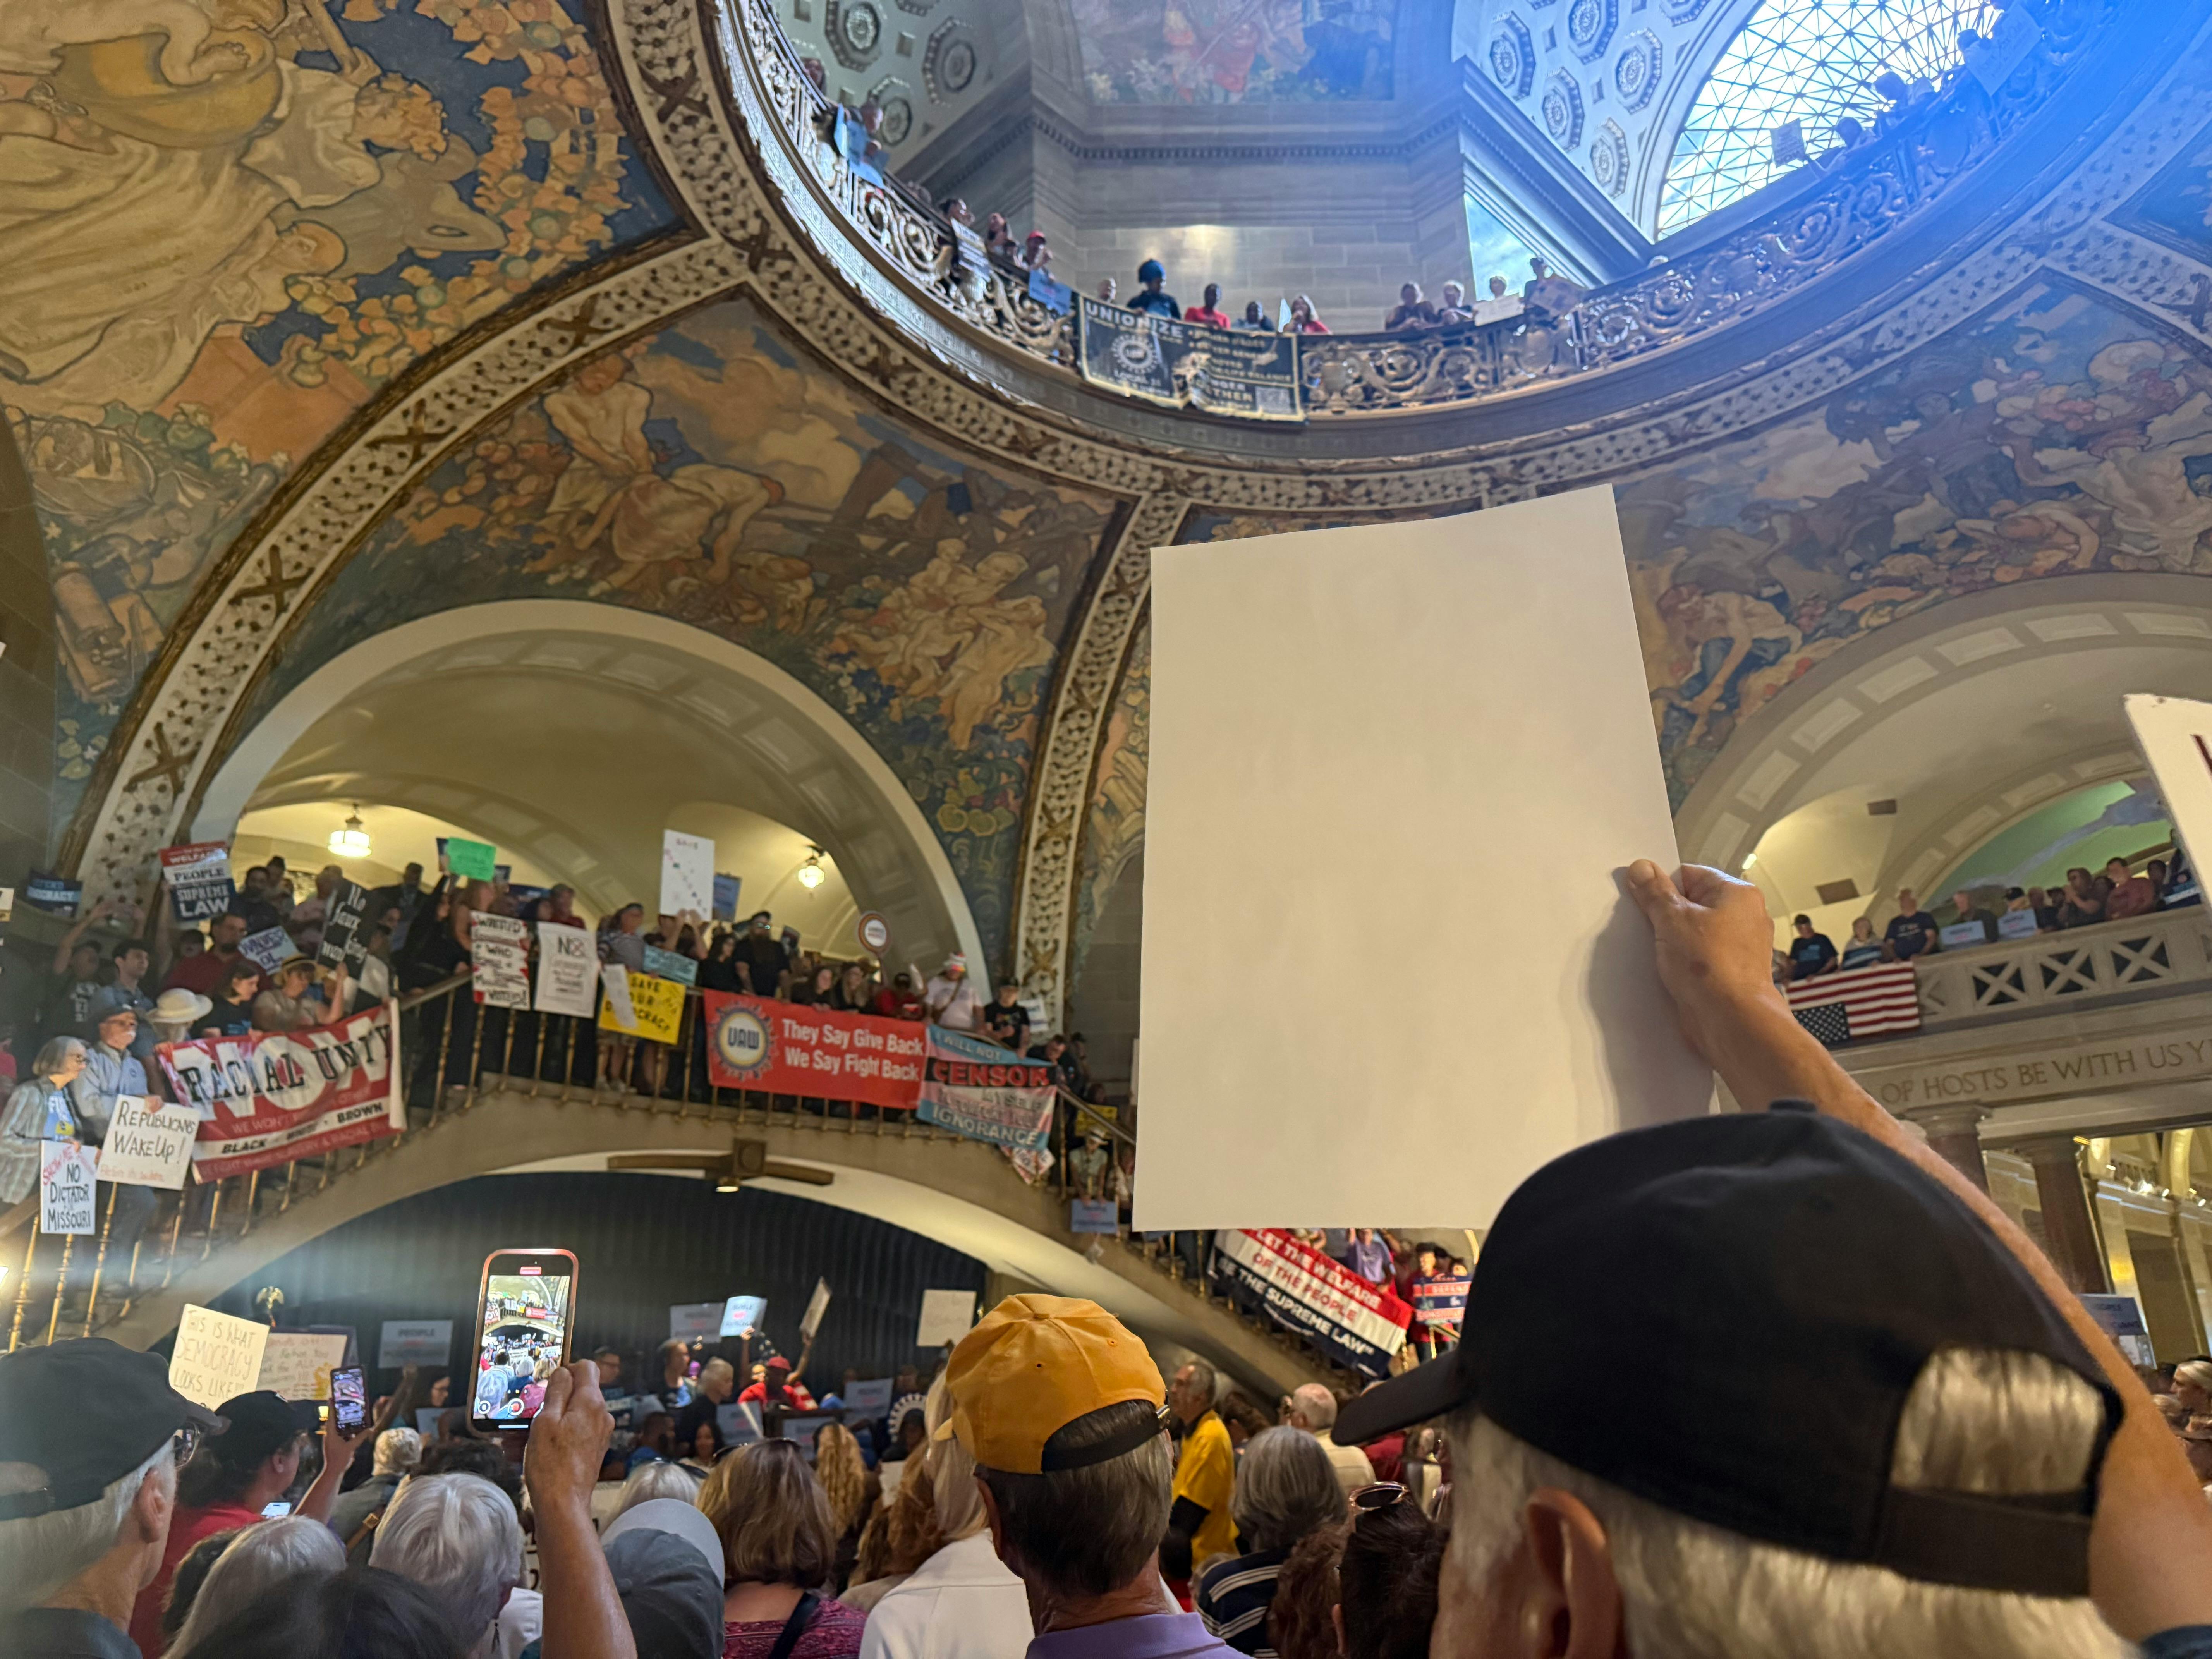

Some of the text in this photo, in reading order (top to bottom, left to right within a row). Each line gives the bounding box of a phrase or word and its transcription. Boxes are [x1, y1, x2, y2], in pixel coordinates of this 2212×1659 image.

[1086, 301, 1183, 338] UNIONIZE
[174, 867, 225, 881] PEOPLE
[177, 884, 228, 902] SUPREME
[179, 897, 230, 918] LAW
[630, 976, 661, 993] SAVE
[605, 1000, 671, 1033] DCRACY
[728, 1027, 760, 1050] UAW
[782, 1018, 924, 1056] They Say Give Back
[178, 1053, 305, 1102] RACIAL
[785, 1047, 920, 1081] We Say Fight Back
[933, 1061, 1050, 1087] CENSOR
[1881, 1039, 2212, 1104] OF HOSTS BE WITH US Y
[222, 1139, 266, 1154] BLACK
[337, 1101, 383, 1123] BROWN
[933, 1104, 1038, 1146] IGNORANCE
[114, 1131, 153, 1157] WAKE
[66, 1163, 81, 1183] NO
[50, 1182, 89, 1203] DICTATOR
[48, 1208, 91, 1231] MISSOURI
[1256, 1231, 1382, 1310] LET THE WELFARE
[1216, 1257, 1238, 1276] BE
[1238, 1269, 1267, 1295] THE
[1265, 1287, 1333, 1335] SUPREME
[1252, 1252, 1274, 1268] OF
[1276, 1265, 1303, 1289] THE
[1303, 1284, 1358, 1323] PEOPLE
[226, 1322, 256, 1349] WHAT
[175, 1335, 253, 1381] DEMOCRACY
[174, 1367, 203, 1392] LOOKS
